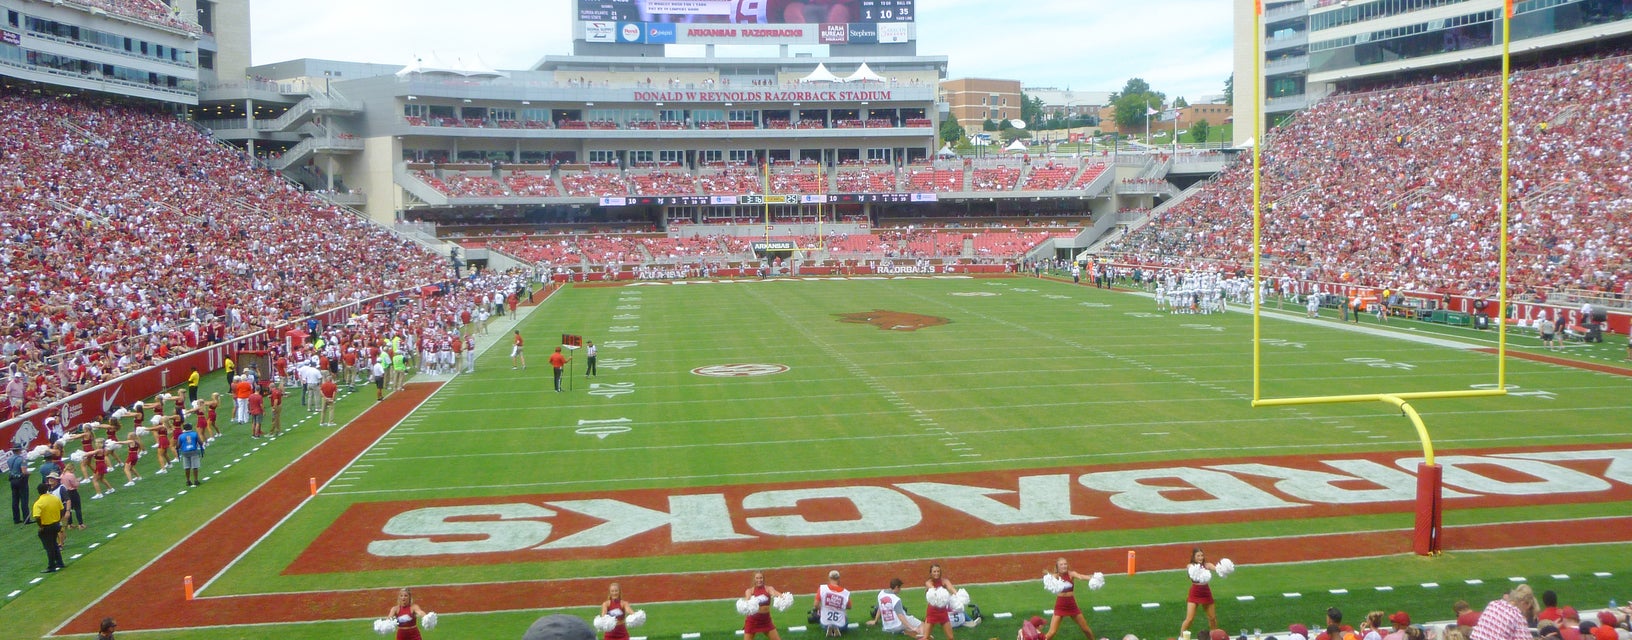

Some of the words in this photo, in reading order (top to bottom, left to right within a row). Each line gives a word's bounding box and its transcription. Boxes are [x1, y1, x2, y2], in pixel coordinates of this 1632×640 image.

[865, 10, 872, 19] 1
[880, 10, 892, 19] 10
[687, 29, 737, 37] ARKANSAS
[741, 29, 803, 37] RAZORBACKS
[849, 29, 876, 38] Stephens
[633, 91, 683, 101] DONALD
[685, 91, 697, 101] W
[699, 91, 761, 101] REYNOLDS
[764, 91, 836, 101] RAZORBACK
[839, 91, 891, 100] STADIUM
[575, 417, 632, 434] 10
[827, 611, 839, 622] 26
